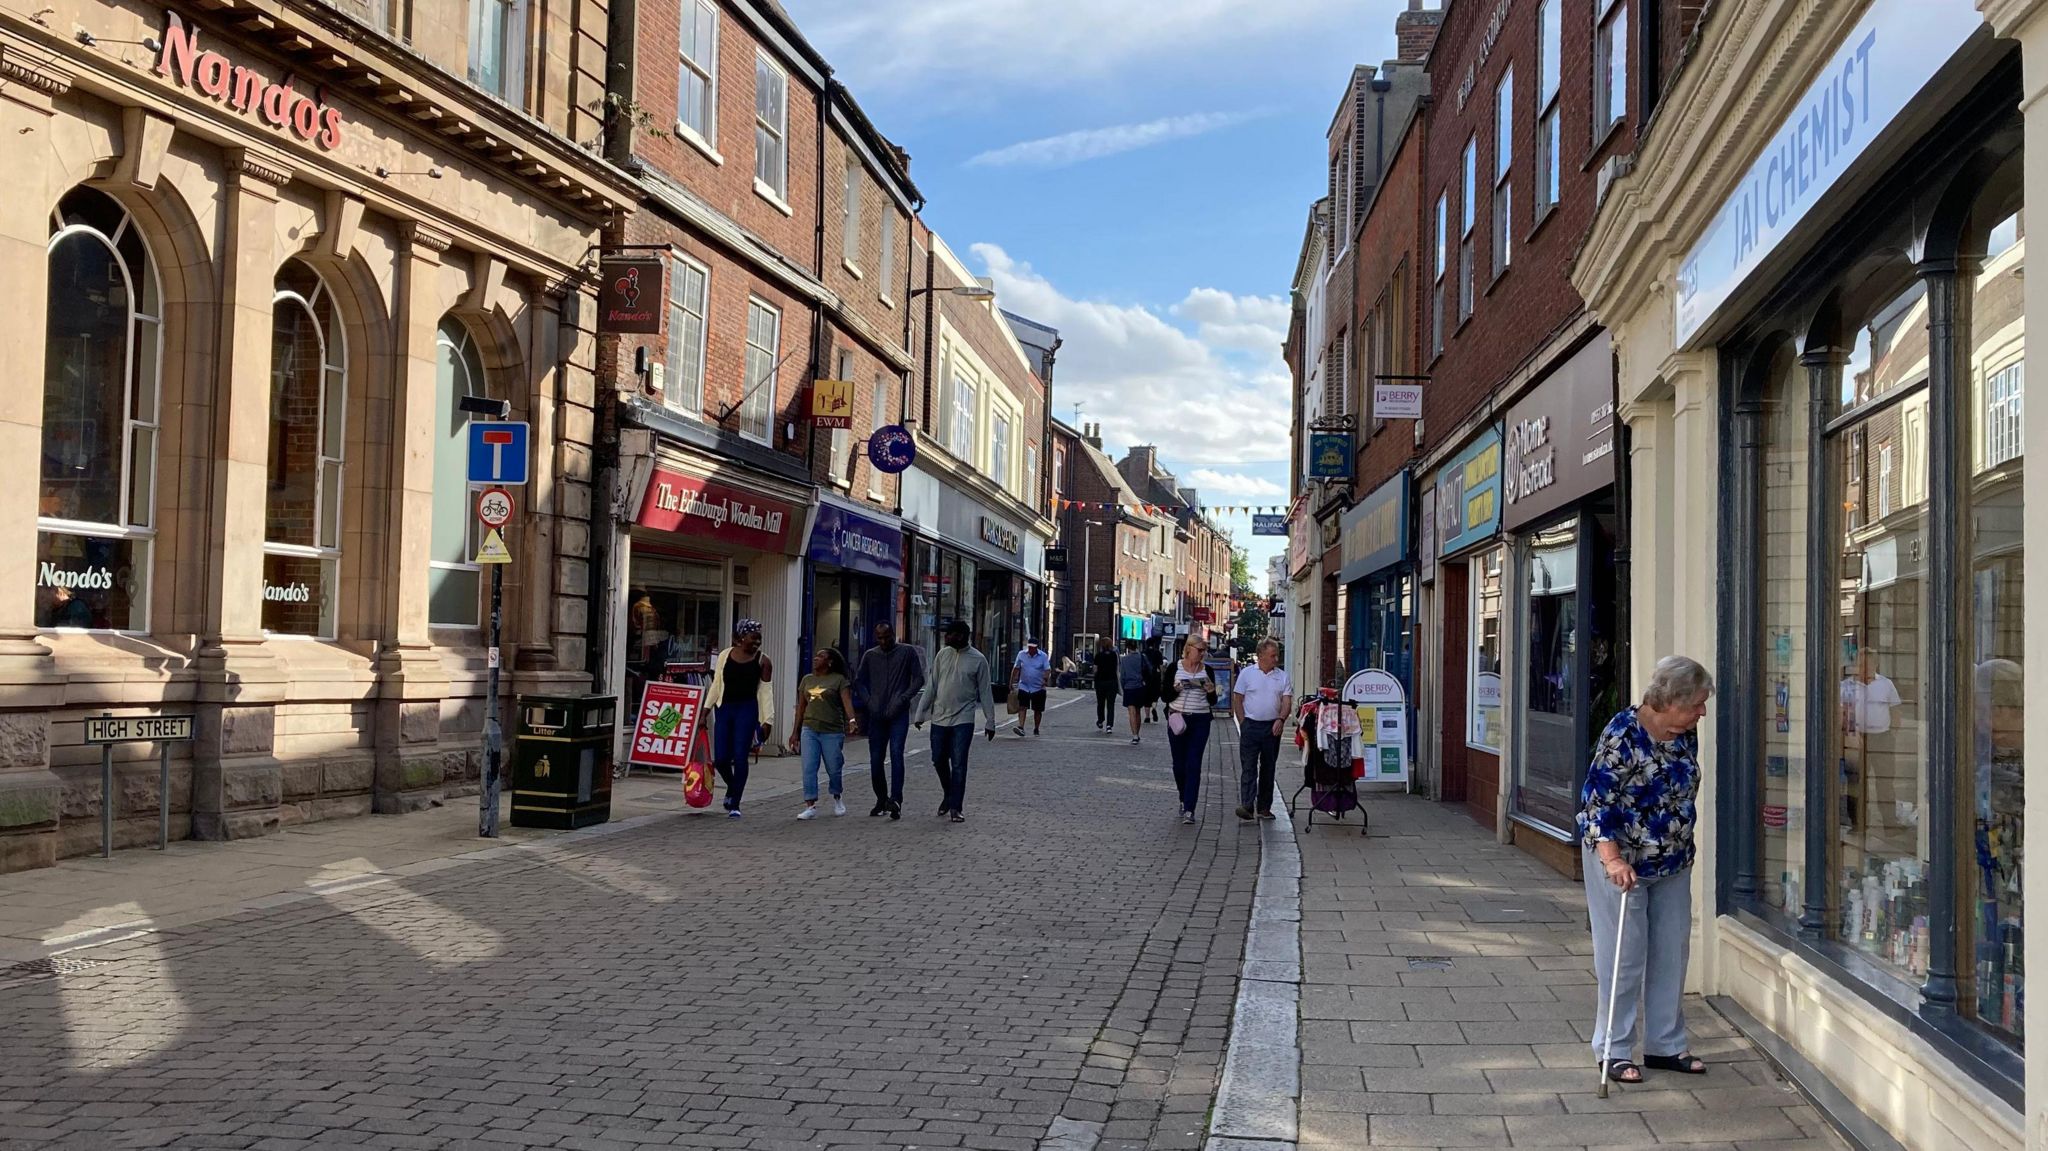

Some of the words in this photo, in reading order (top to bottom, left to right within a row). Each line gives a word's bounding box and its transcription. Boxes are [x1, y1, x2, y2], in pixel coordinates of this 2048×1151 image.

[156, 10, 342, 149] Nando's
[1733, 180, 1759, 270] JAI
[1766, 28, 1876, 229] CHEMIST
[608, 310, 652, 321] Nando's
[1390, 391, 1419, 403] BERRY
[816, 417, 845, 427] EWM
[1519, 416, 1548, 457] Home
[1519, 446, 1554, 500] Instead
[656, 483, 679, 511] The
[679, 488, 728, 528] Edinburgh
[730, 501, 763, 530] Woollen
[763, 511, 783, 534] Mill
[841, 530, 861, 552] CANCER
[862, 535, 882, 558] RESEARCH
[37, 561, 113, 589] Nando's
[1364, 683, 1394, 695] BERRY
[93, 721, 128, 738] HIGH
[136, 719, 186, 736] STREET
[533, 727, 556, 736] Litter
[655, 721, 672, 735] OFF
[636, 736, 687, 756] SALE
